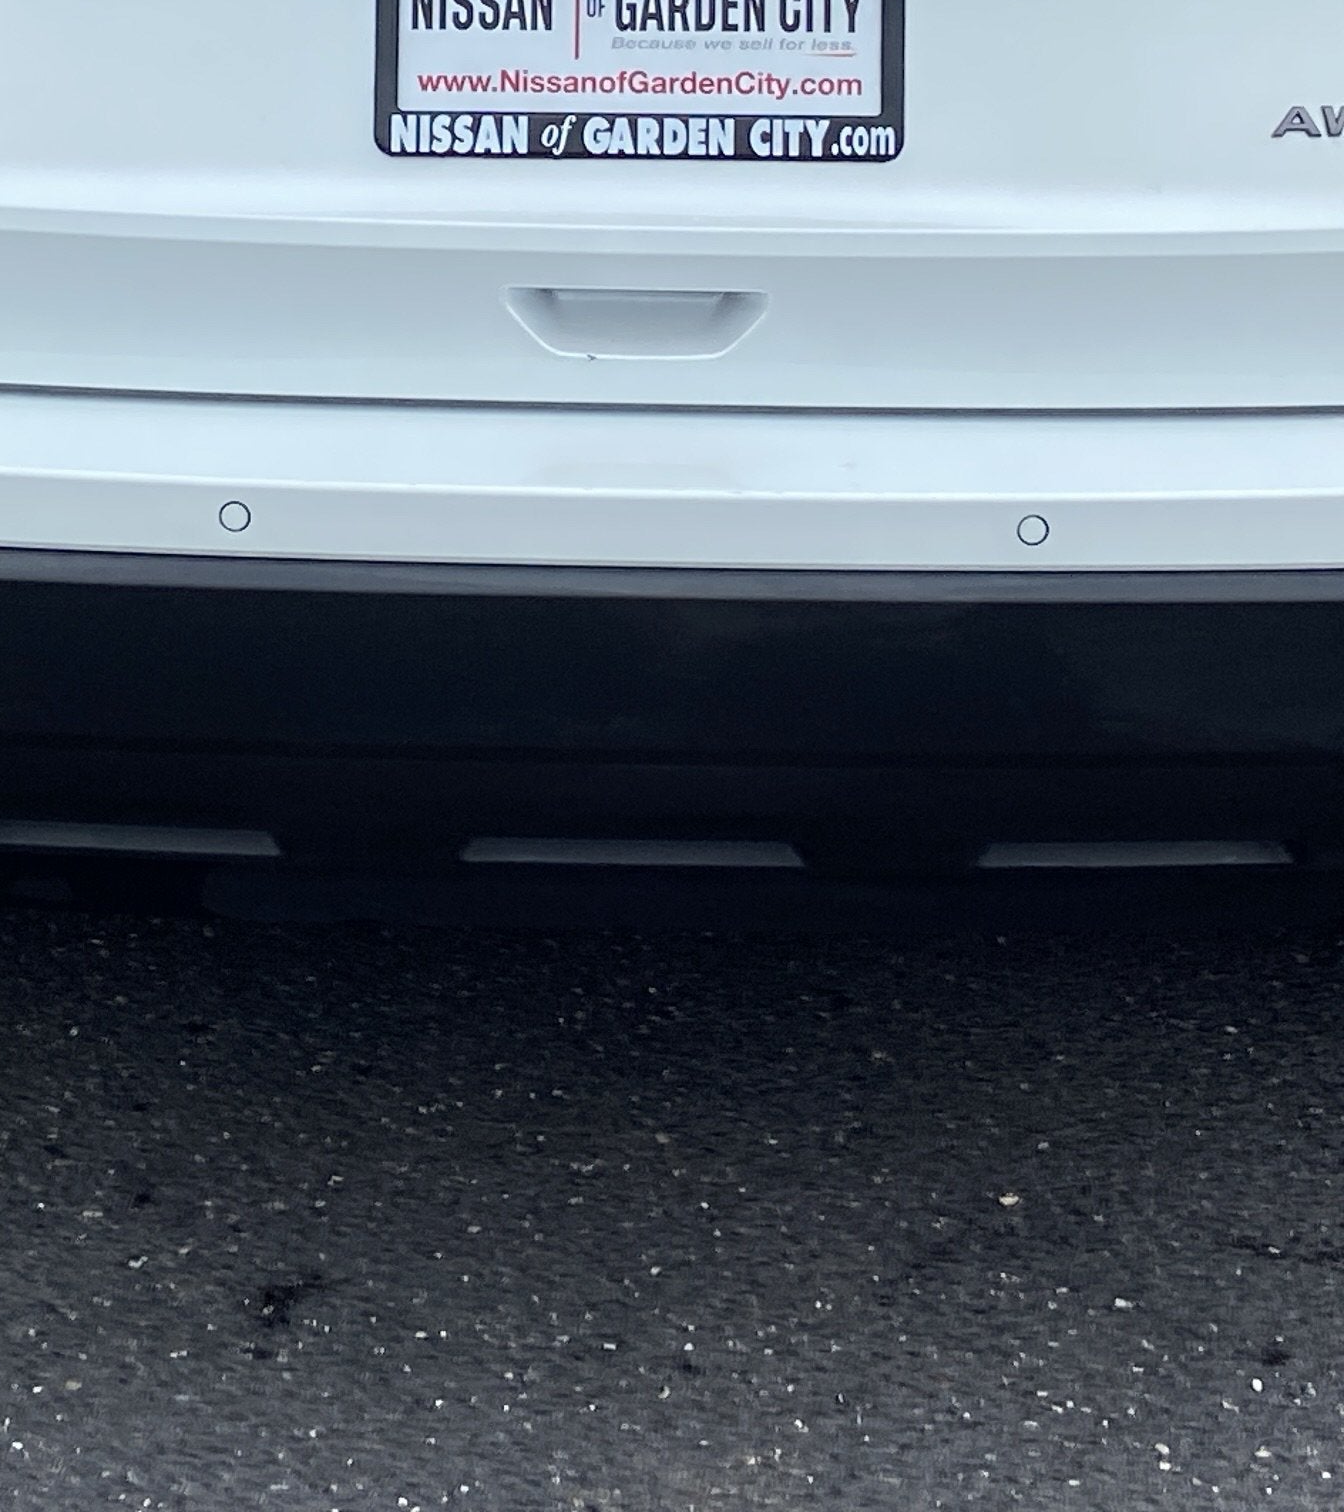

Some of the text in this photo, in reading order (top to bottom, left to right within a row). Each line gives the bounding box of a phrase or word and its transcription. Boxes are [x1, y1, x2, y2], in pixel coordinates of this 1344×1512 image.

[611, 37, 697, 50] Because
[704, 39, 732, 51] we
[739, 37, 773, 51] sell
[779, 38, 806, 51] for
[417, 69, 863, 100] www.NissanofGardenCity.com
[389, 113, 896, 158] NISSAN of GARDEN CITY.com
